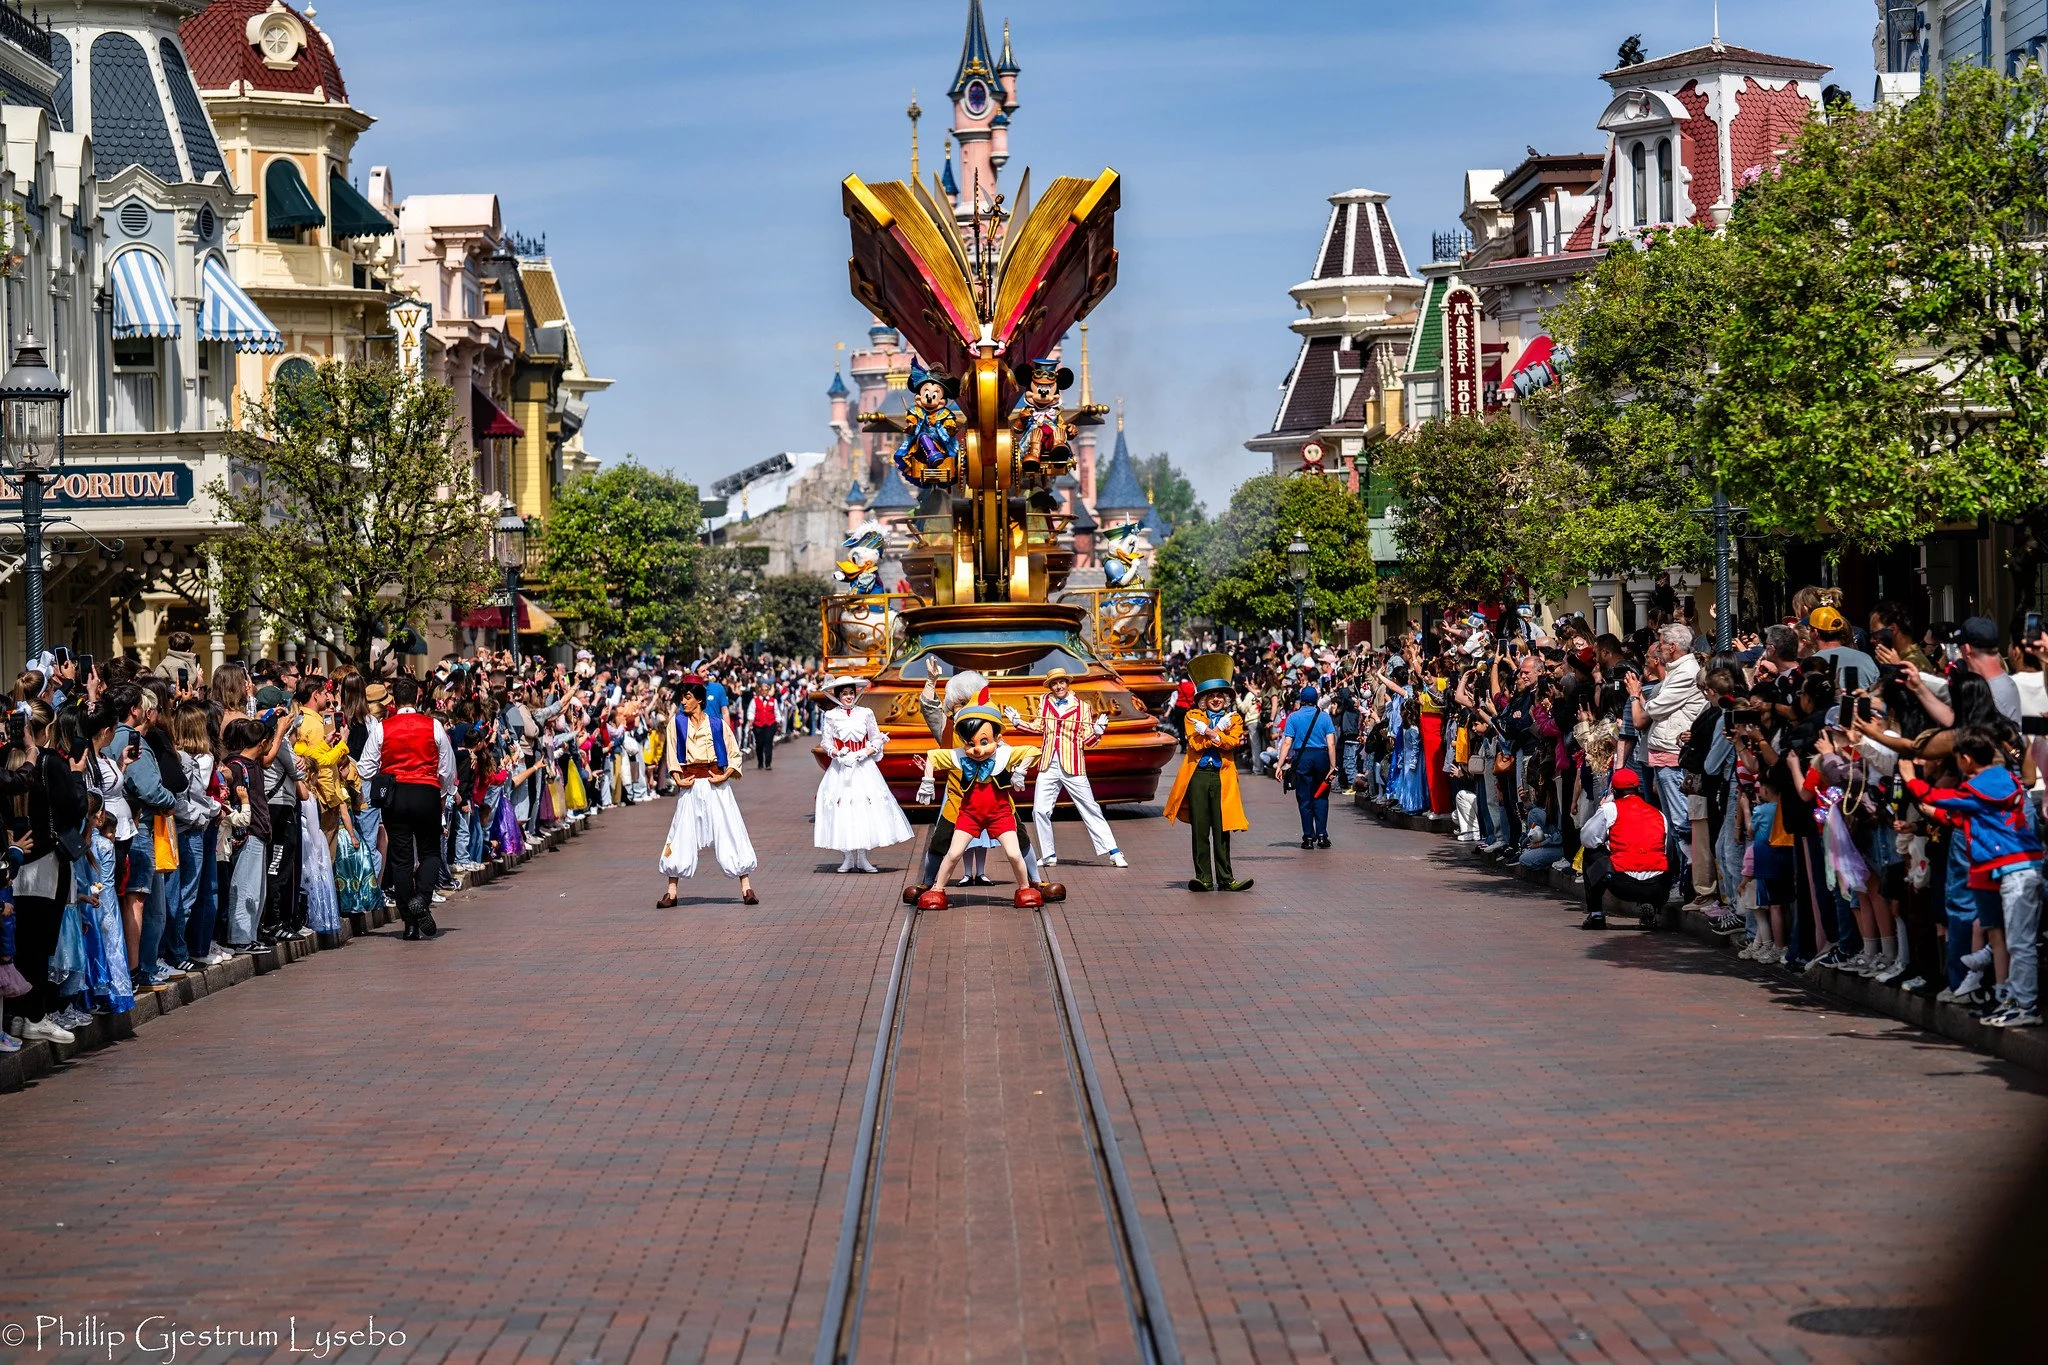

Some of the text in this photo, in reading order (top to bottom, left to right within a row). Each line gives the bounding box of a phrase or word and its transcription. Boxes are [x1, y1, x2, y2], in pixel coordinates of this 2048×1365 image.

[1453, 302, 1470, 417] MARKET HOU
[0, 471, 175, 499] EPORIUM
